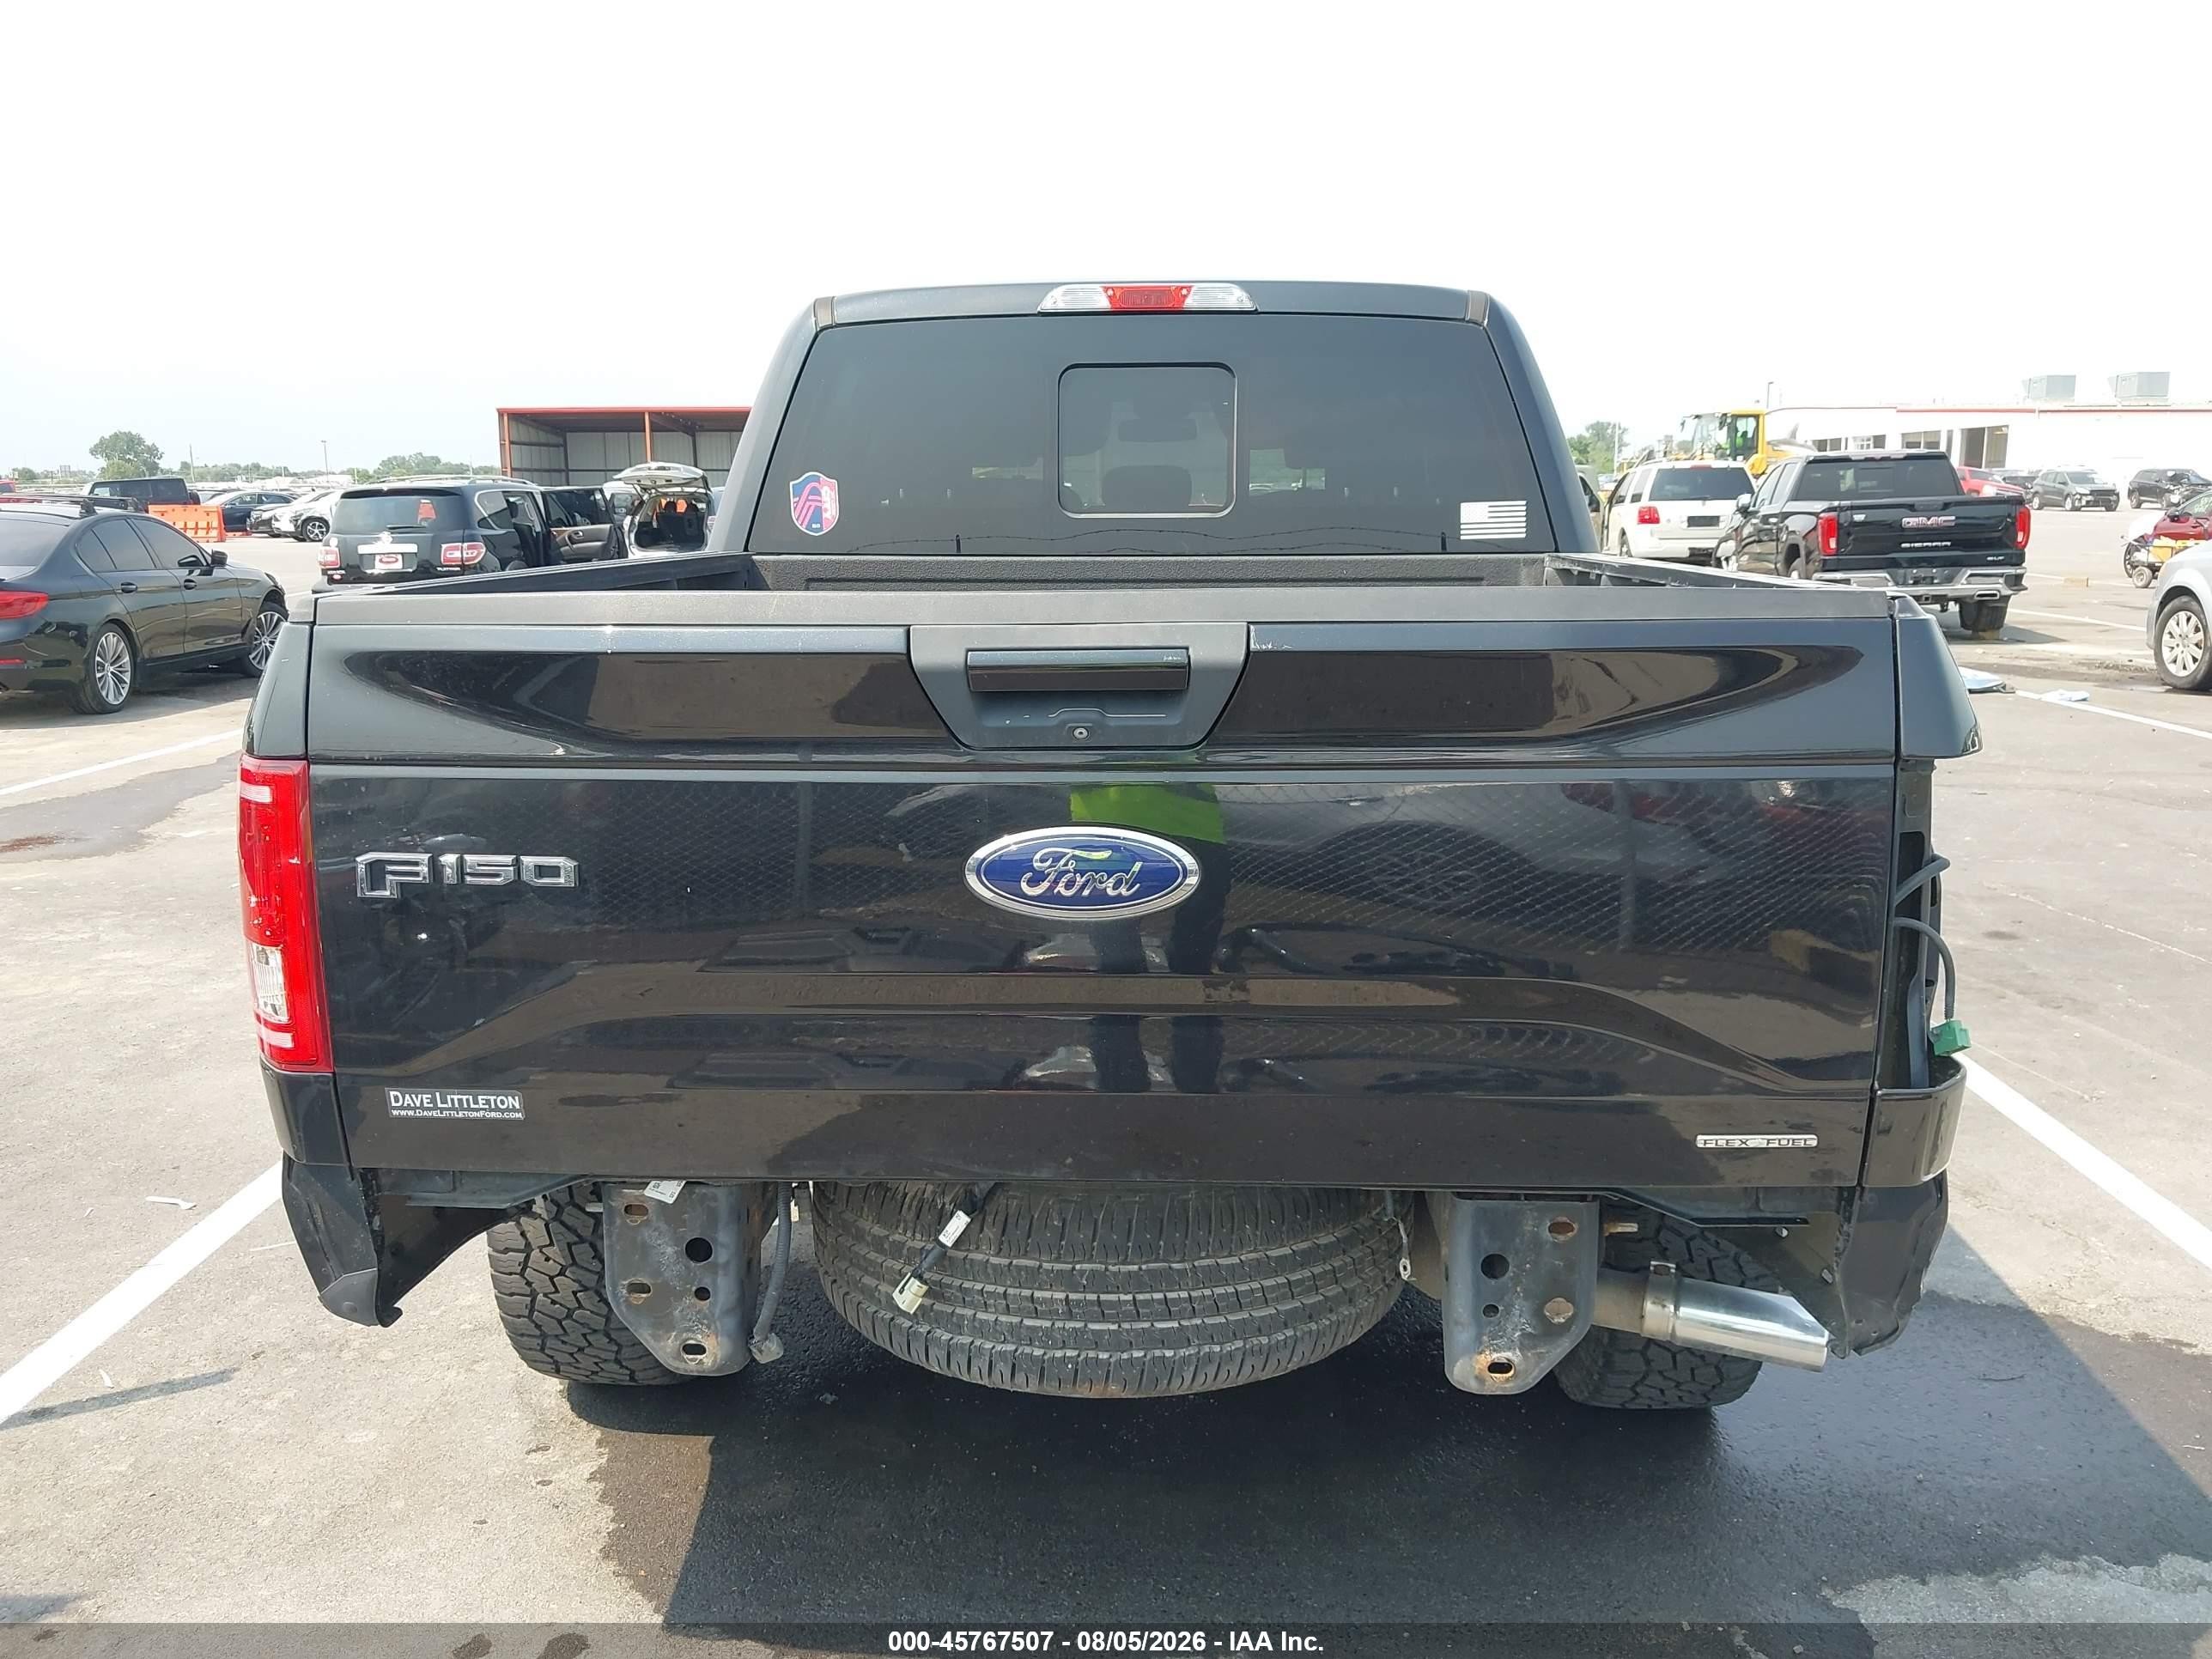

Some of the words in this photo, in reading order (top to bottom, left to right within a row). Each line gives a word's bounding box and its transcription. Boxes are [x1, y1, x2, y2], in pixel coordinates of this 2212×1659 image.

[1901, 516, 1956, 529] GMC
[1020, 847, 1143, 896] Ford
[389, 1091, 433, 1107] DAVE
[435, 1092, 520, 1109] LITTLETON
[1704, 1139, 1750, 1147] FLEX
[1765, 1138, 1815, 1146] FUEL
